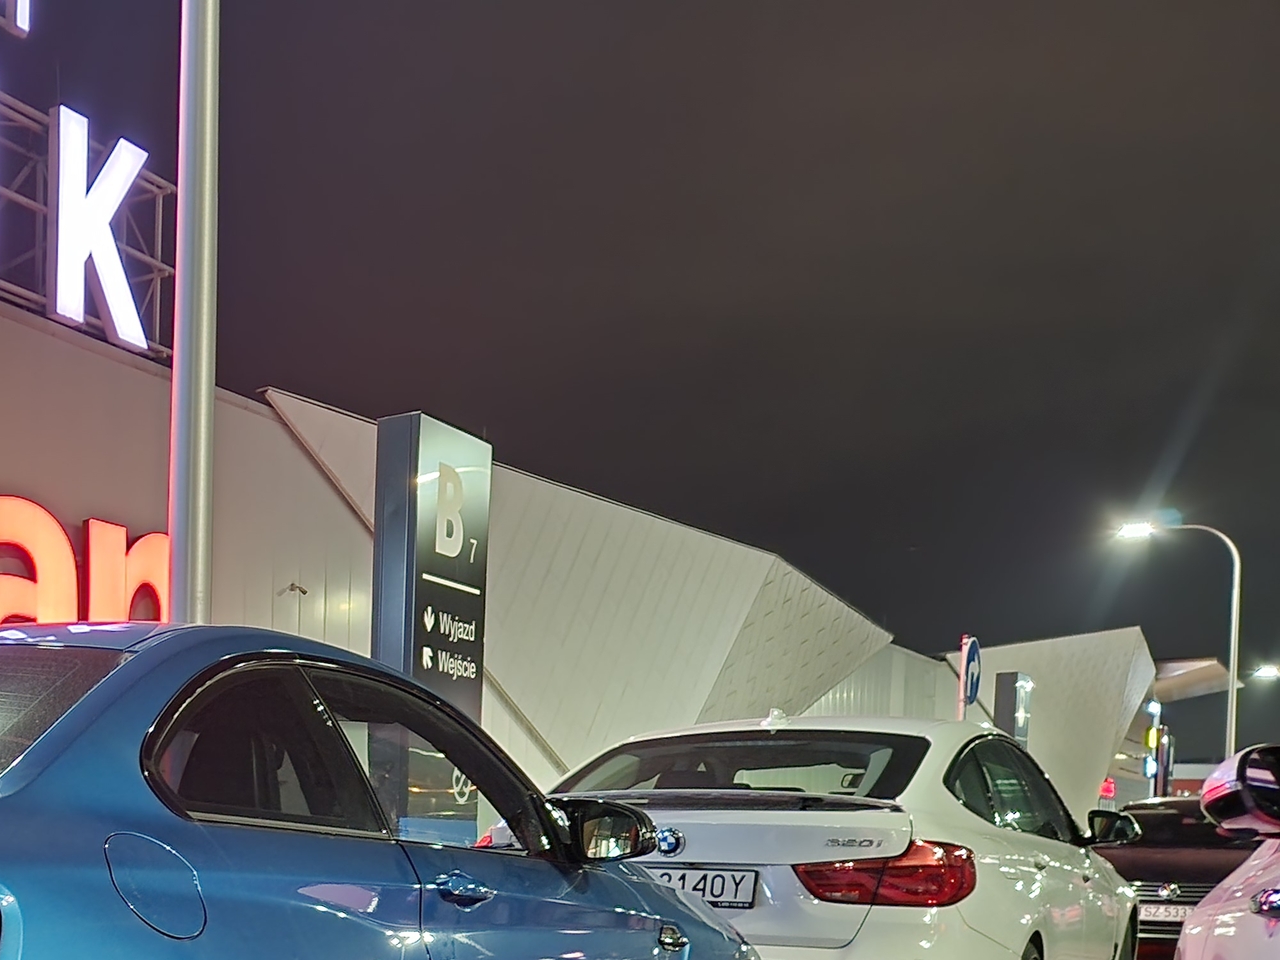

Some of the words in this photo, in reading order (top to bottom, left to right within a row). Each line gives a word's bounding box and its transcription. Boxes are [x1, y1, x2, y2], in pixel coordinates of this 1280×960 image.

[435, 461, 464, 558] B
[469, 538, 478, 563] 7
[438, 611, 476, 643] Wyjazd
[437, 649, 477, 681] Wejście
